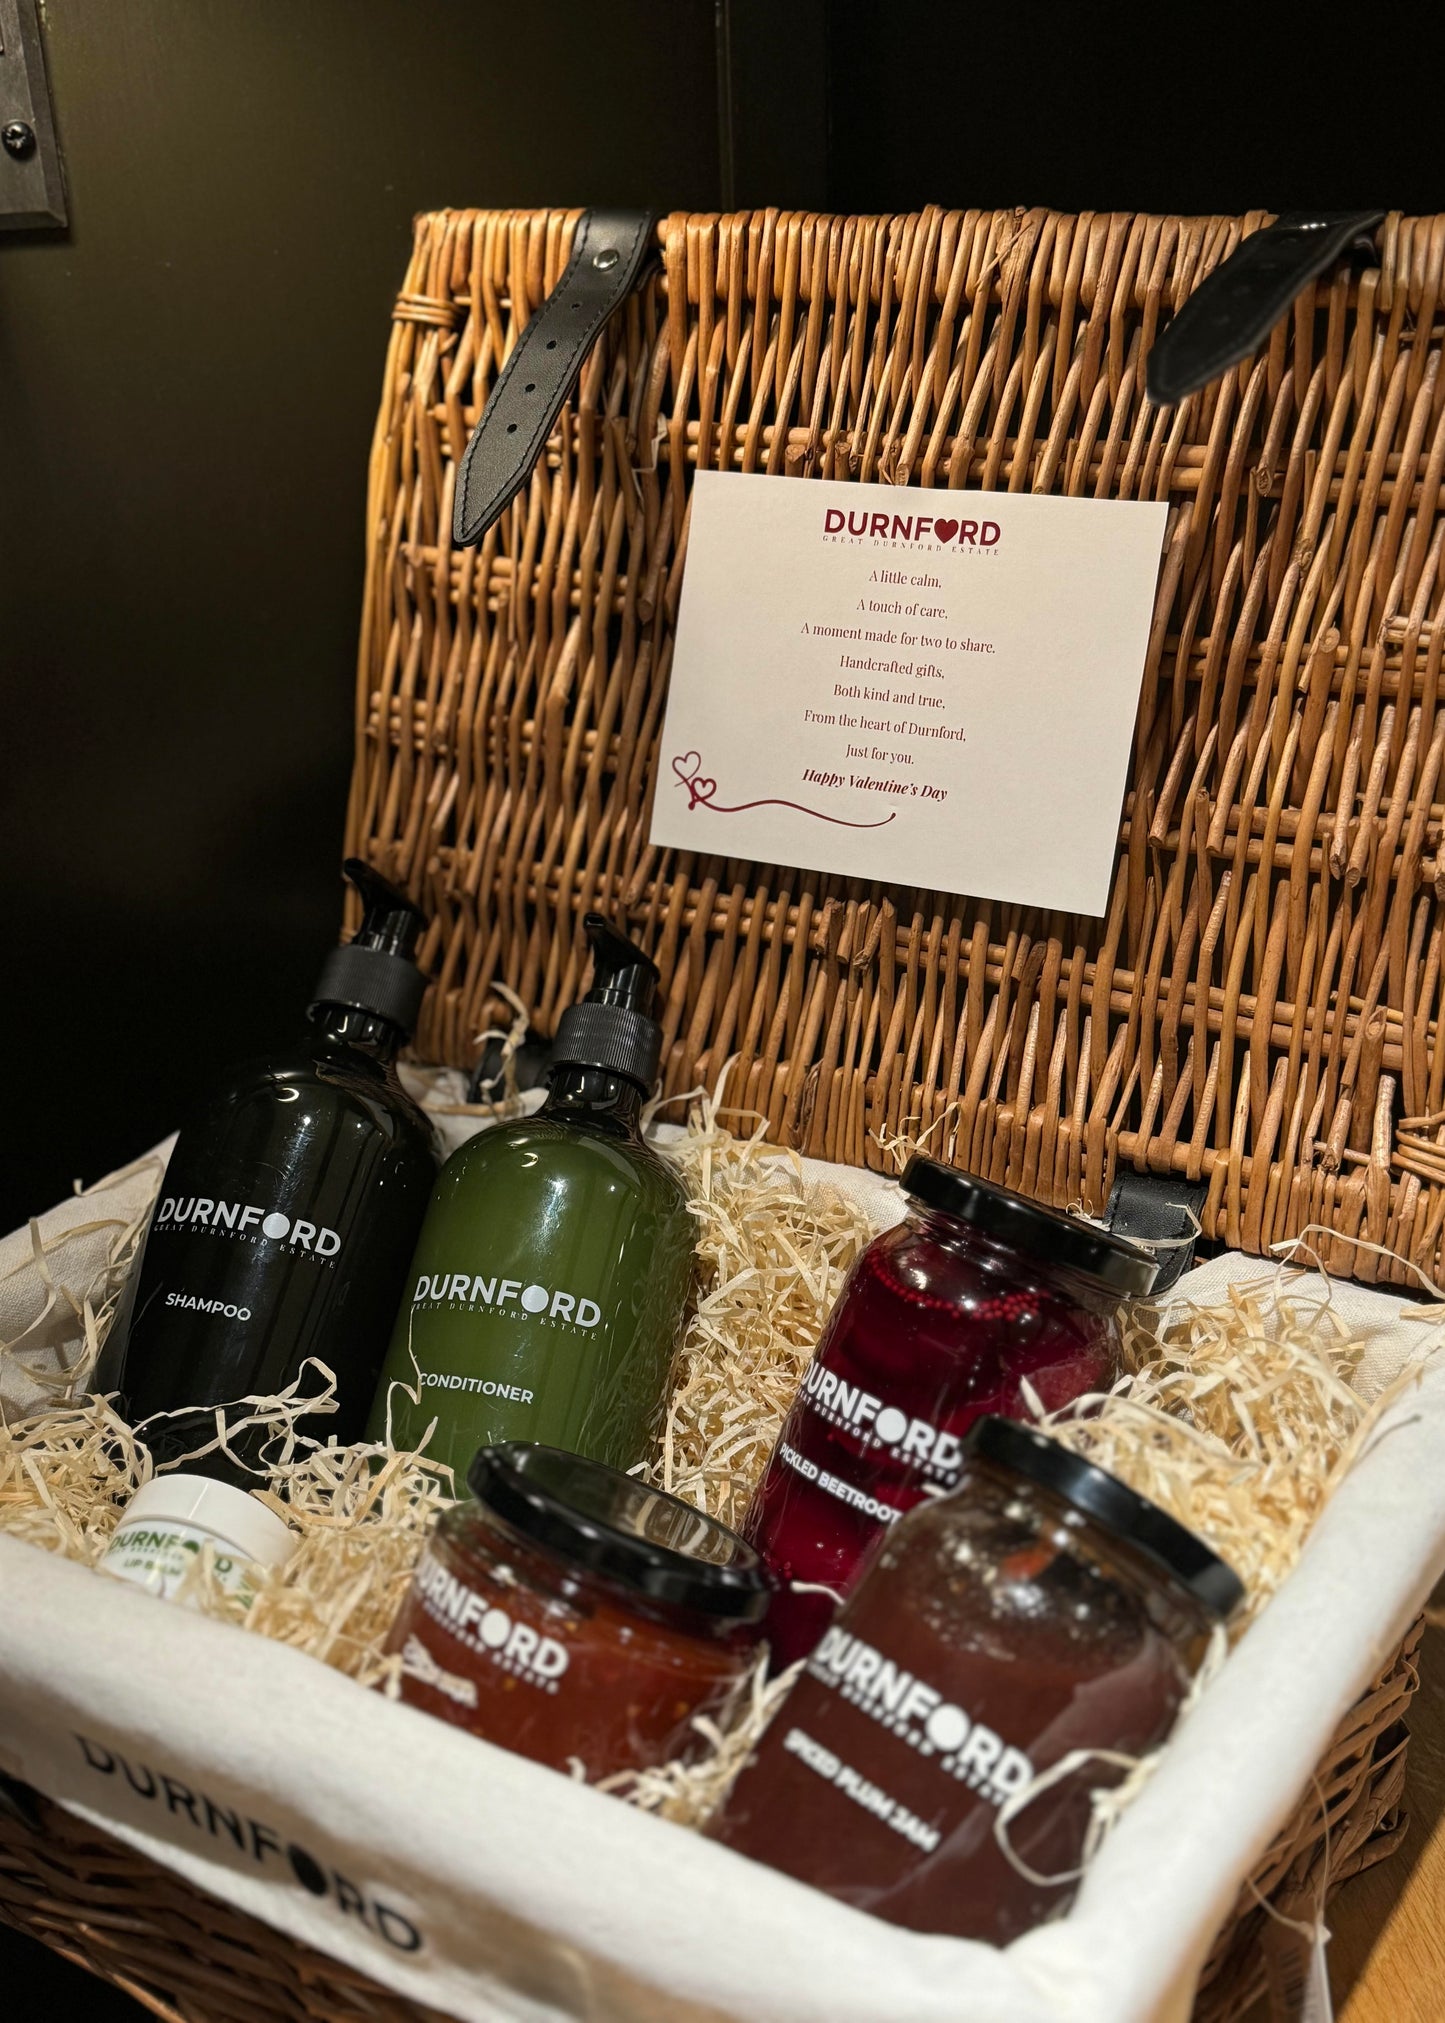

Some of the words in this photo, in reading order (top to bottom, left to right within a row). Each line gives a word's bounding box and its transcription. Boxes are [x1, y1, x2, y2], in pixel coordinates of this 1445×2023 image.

[822, 535, 864, 545] GREAT
[873, 539, 942, 552] DURNFORD
[951, 546, 999, 556] ESTATE
[868, 570, 878, 582] A
[880, 570, 908, 585] little
[910, 573, 942, 589] calm,
[856, 599, 865, 611] A
[869, 599, 902, 614] touch
[905, 603, 919, 616] of
[800, 622, 810, 634] A
[812, 625, 862, 640] moment
[864, 629, 897, 644] made
[900, 632, 918, 646] for
[920, 634, 942, 649] two
[945, 637, 957, 650] to
[959, 638, 996, 654] share.
[839, 655, 913, 675] Handcrafted
[915, 664, 945, 680] gifts,
[833, 684, 861, 699] Both
[863, 686, 890, 702] kind
[892, 692, 915, 705] and
[804, 709, 835, 725] From
[839, 713, 857, 728] the
[860, 716, 892, 732] heart
[893, 721, 907, 734] of
[908, 722, 966, 742] Durnford,
[845, 744, 868, 759] Just
[871, 747, 888, 761] for
[889, 752, 914, 765] you.
[802, 768, 845, 788] Happy
[920, 785, 948, 802] Day
[157, 1197, 342, 1257] DURNFORD
[154, 1224, 185, 1232] GREAT
[191, 1225, 268, 1247] DURNFORD
[279, 1243, 336, 1270] ESTATE
[165, 1292, 252, 1321] SHAMPOO
[413, 1274, 601, 1328] DURNFORD
[449, 1302, 529, 1321] DURNFORD
[539, 1317, 598, 1341] ESTATE
[420, 1373, 534, 1405] CONDITIONER
[779, 1442, 819, 1480] PICKLED
[817, 1471, 903, 1525] BEETROOT
[123, 1558, 143, 1568] LIP
